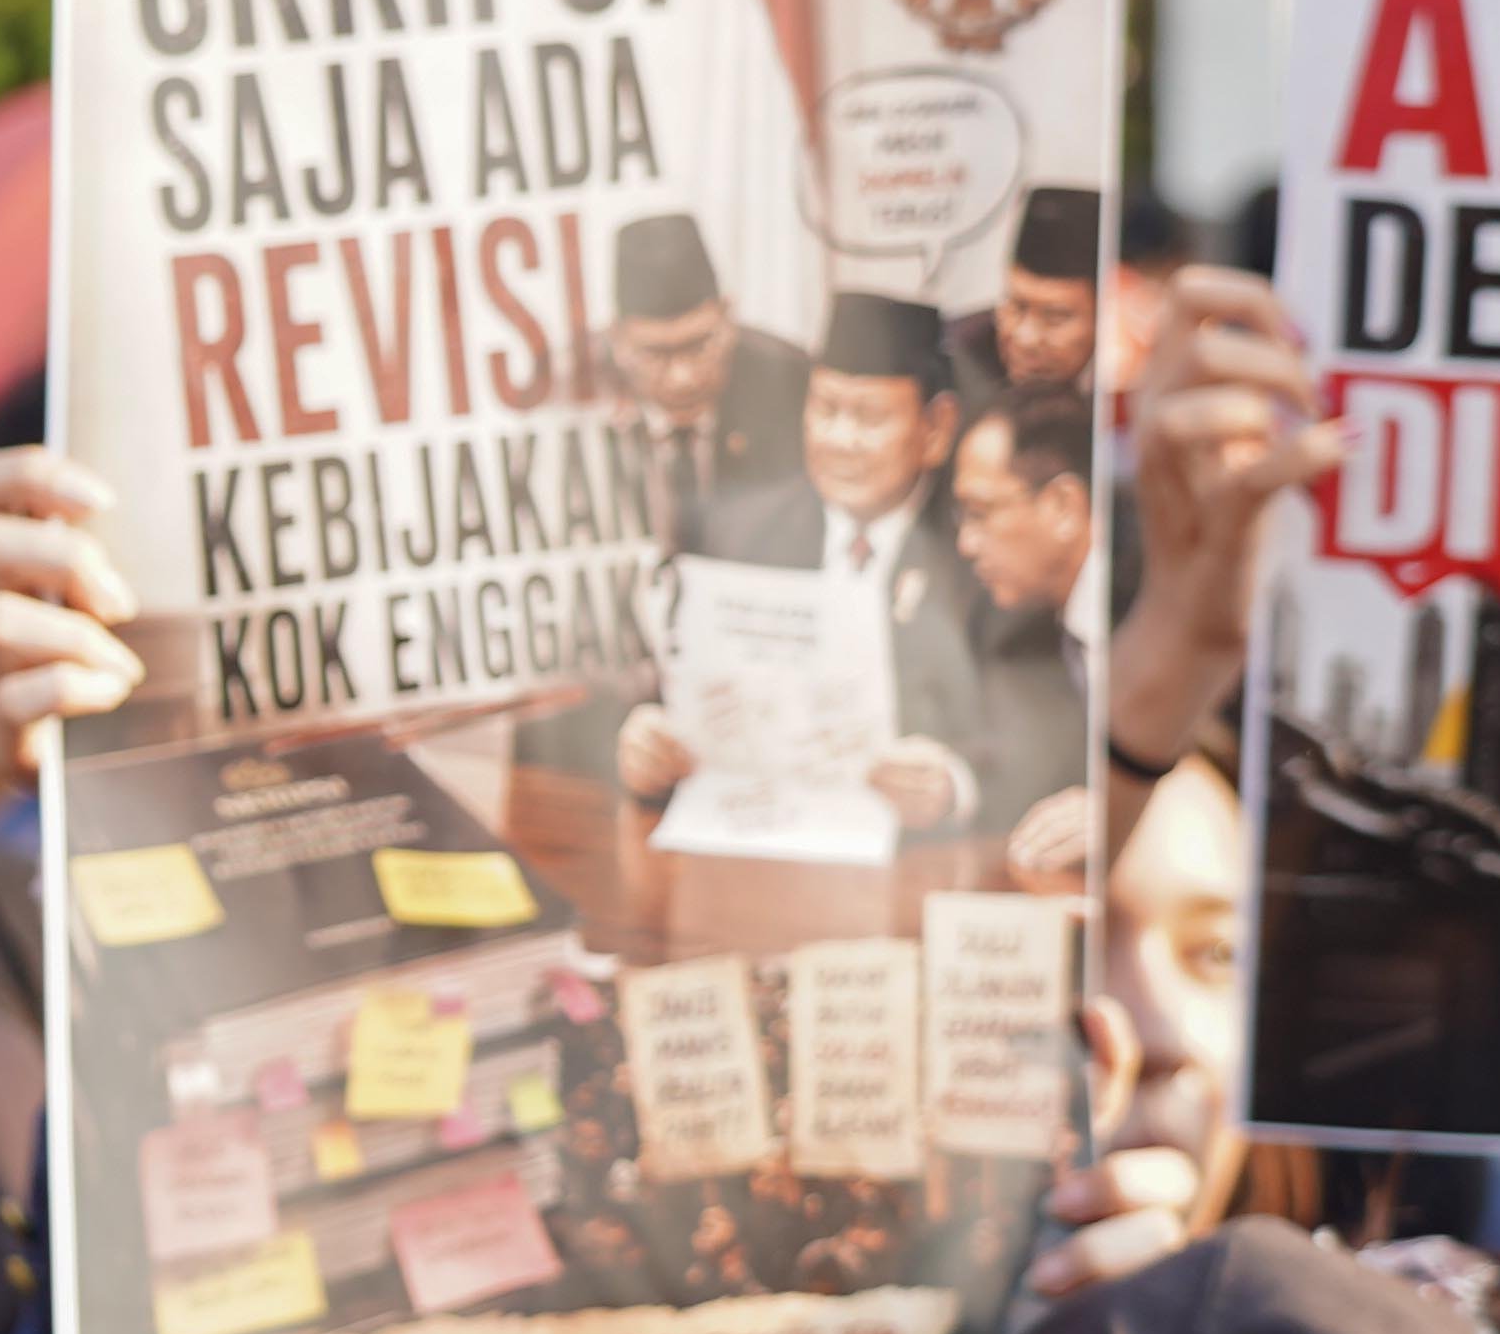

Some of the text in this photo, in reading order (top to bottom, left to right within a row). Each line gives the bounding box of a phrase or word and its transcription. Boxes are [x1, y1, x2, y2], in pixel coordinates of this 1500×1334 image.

[152, 33, 659, 235] SAJA ADA
[193, 421, 655, 598] KEBIJAKAN
[212, 602, 359, 724] KOK
[393, 555, 685, 694] ENGGAK?
